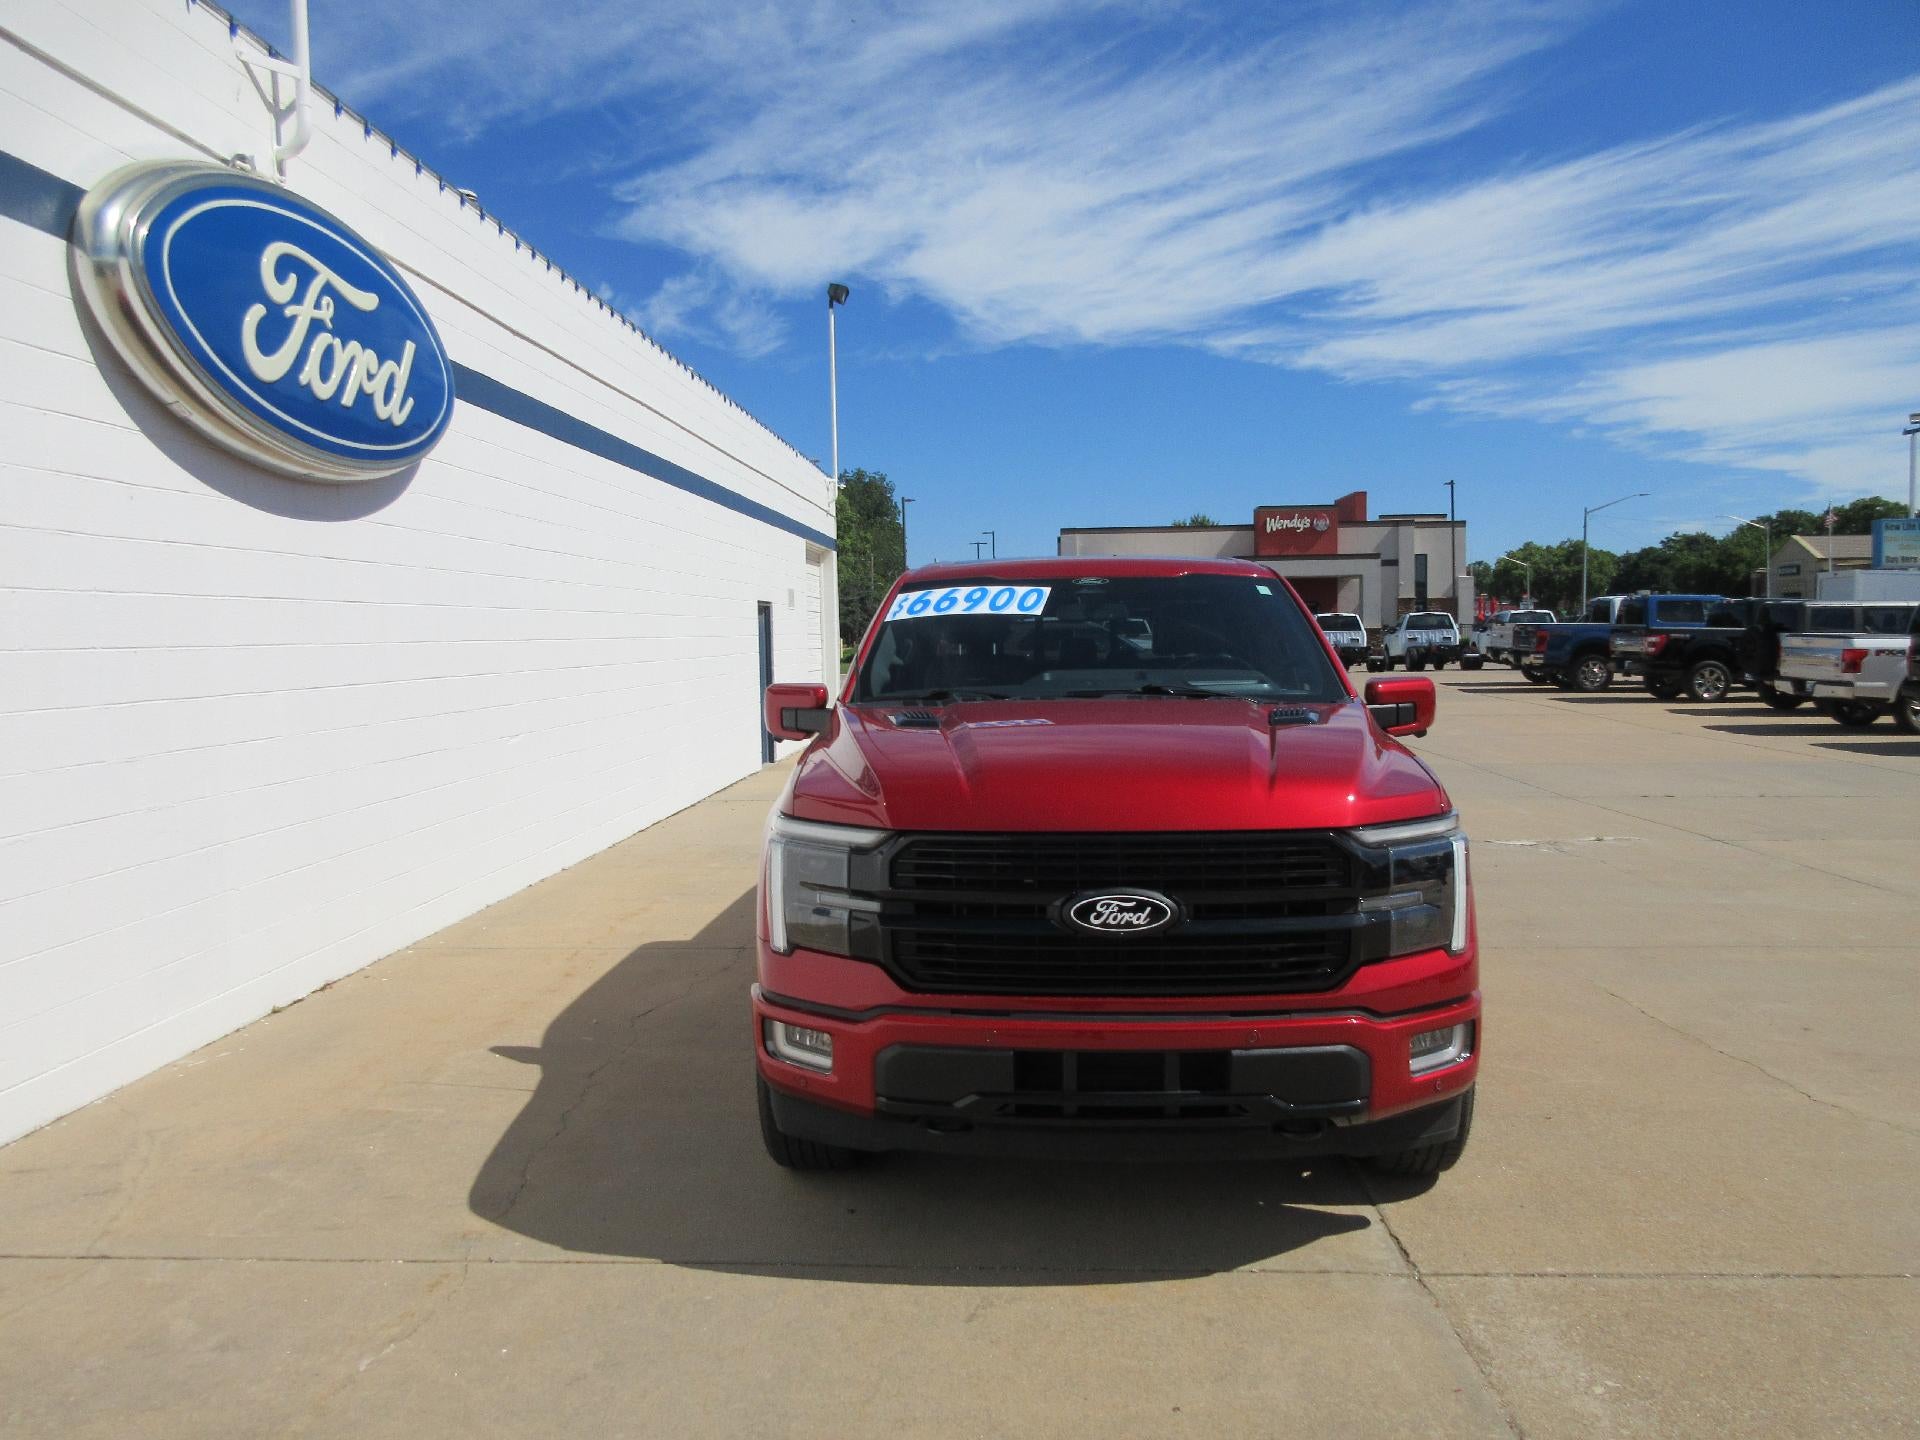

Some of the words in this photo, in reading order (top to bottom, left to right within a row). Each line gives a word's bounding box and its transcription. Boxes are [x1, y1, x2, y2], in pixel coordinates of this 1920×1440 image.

[242, 240, 416, 426] Ford
[1266, 513, 1311, 534] Wendy's
[891, 586, 1046, 619] $66900
[1090, 899, 1152, 925] Ford
